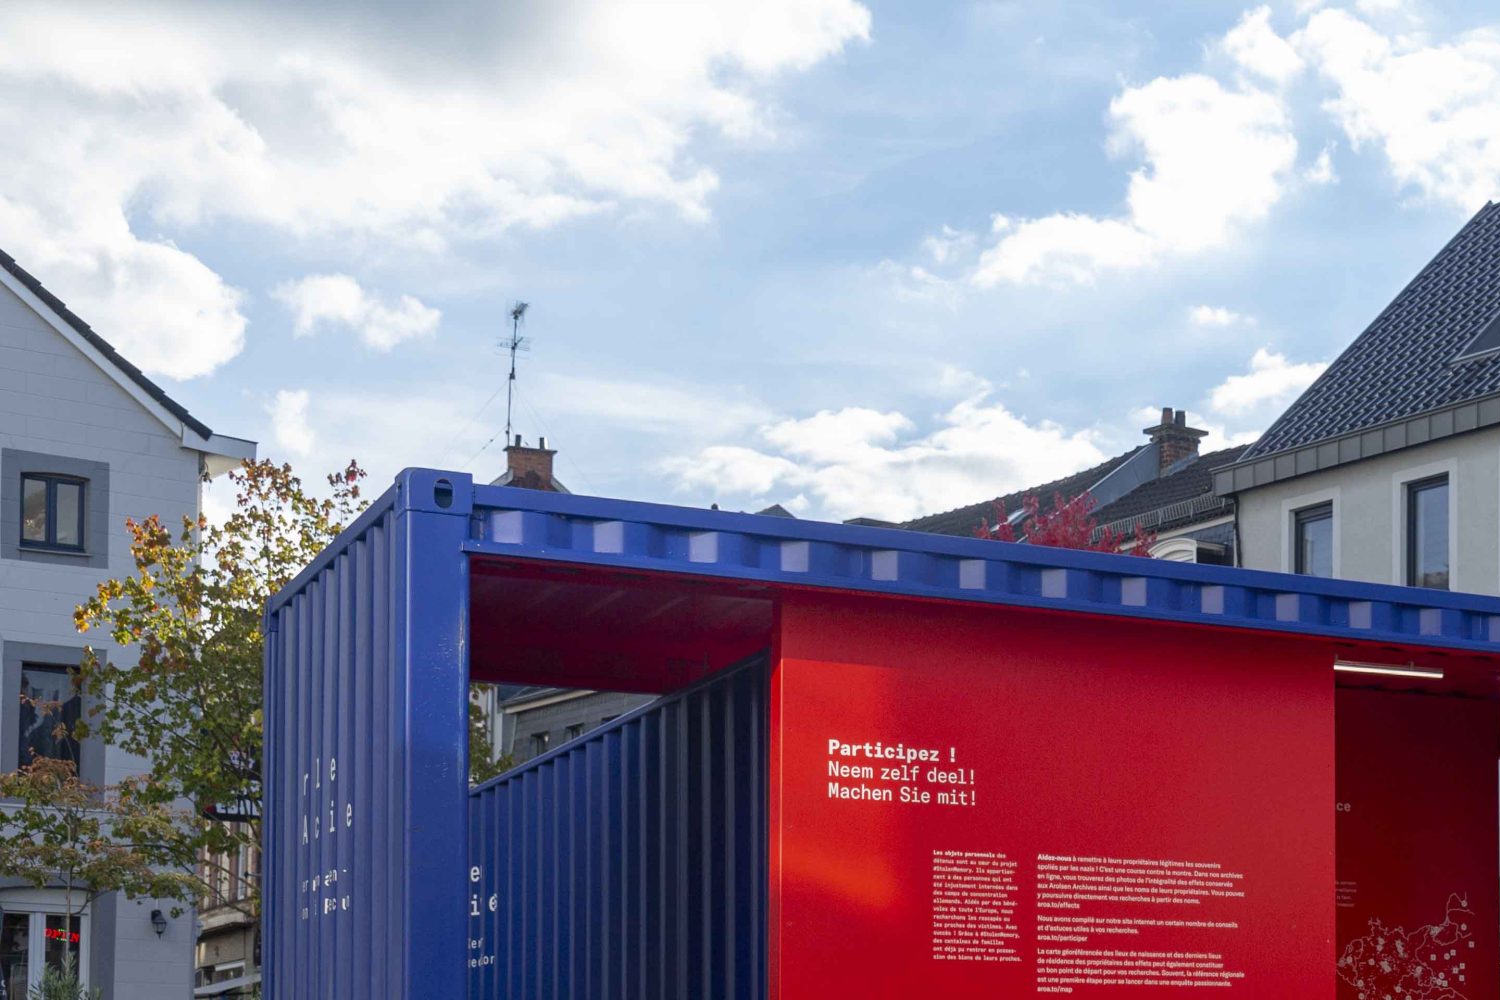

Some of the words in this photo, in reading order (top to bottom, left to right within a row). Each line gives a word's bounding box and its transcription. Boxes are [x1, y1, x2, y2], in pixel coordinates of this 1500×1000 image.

[829, 739, 939, 762] Participez
[950, 747, 956, 762] !
[829, 761, 873, 778] Neem
[881, 765, 919, 781] zelf
[927, 767, 974, 784] deel!
[829, 782, 892, 800] Machen
[900, 786, 930, 803] Sie
[938, 789, 975, 805] mit!
